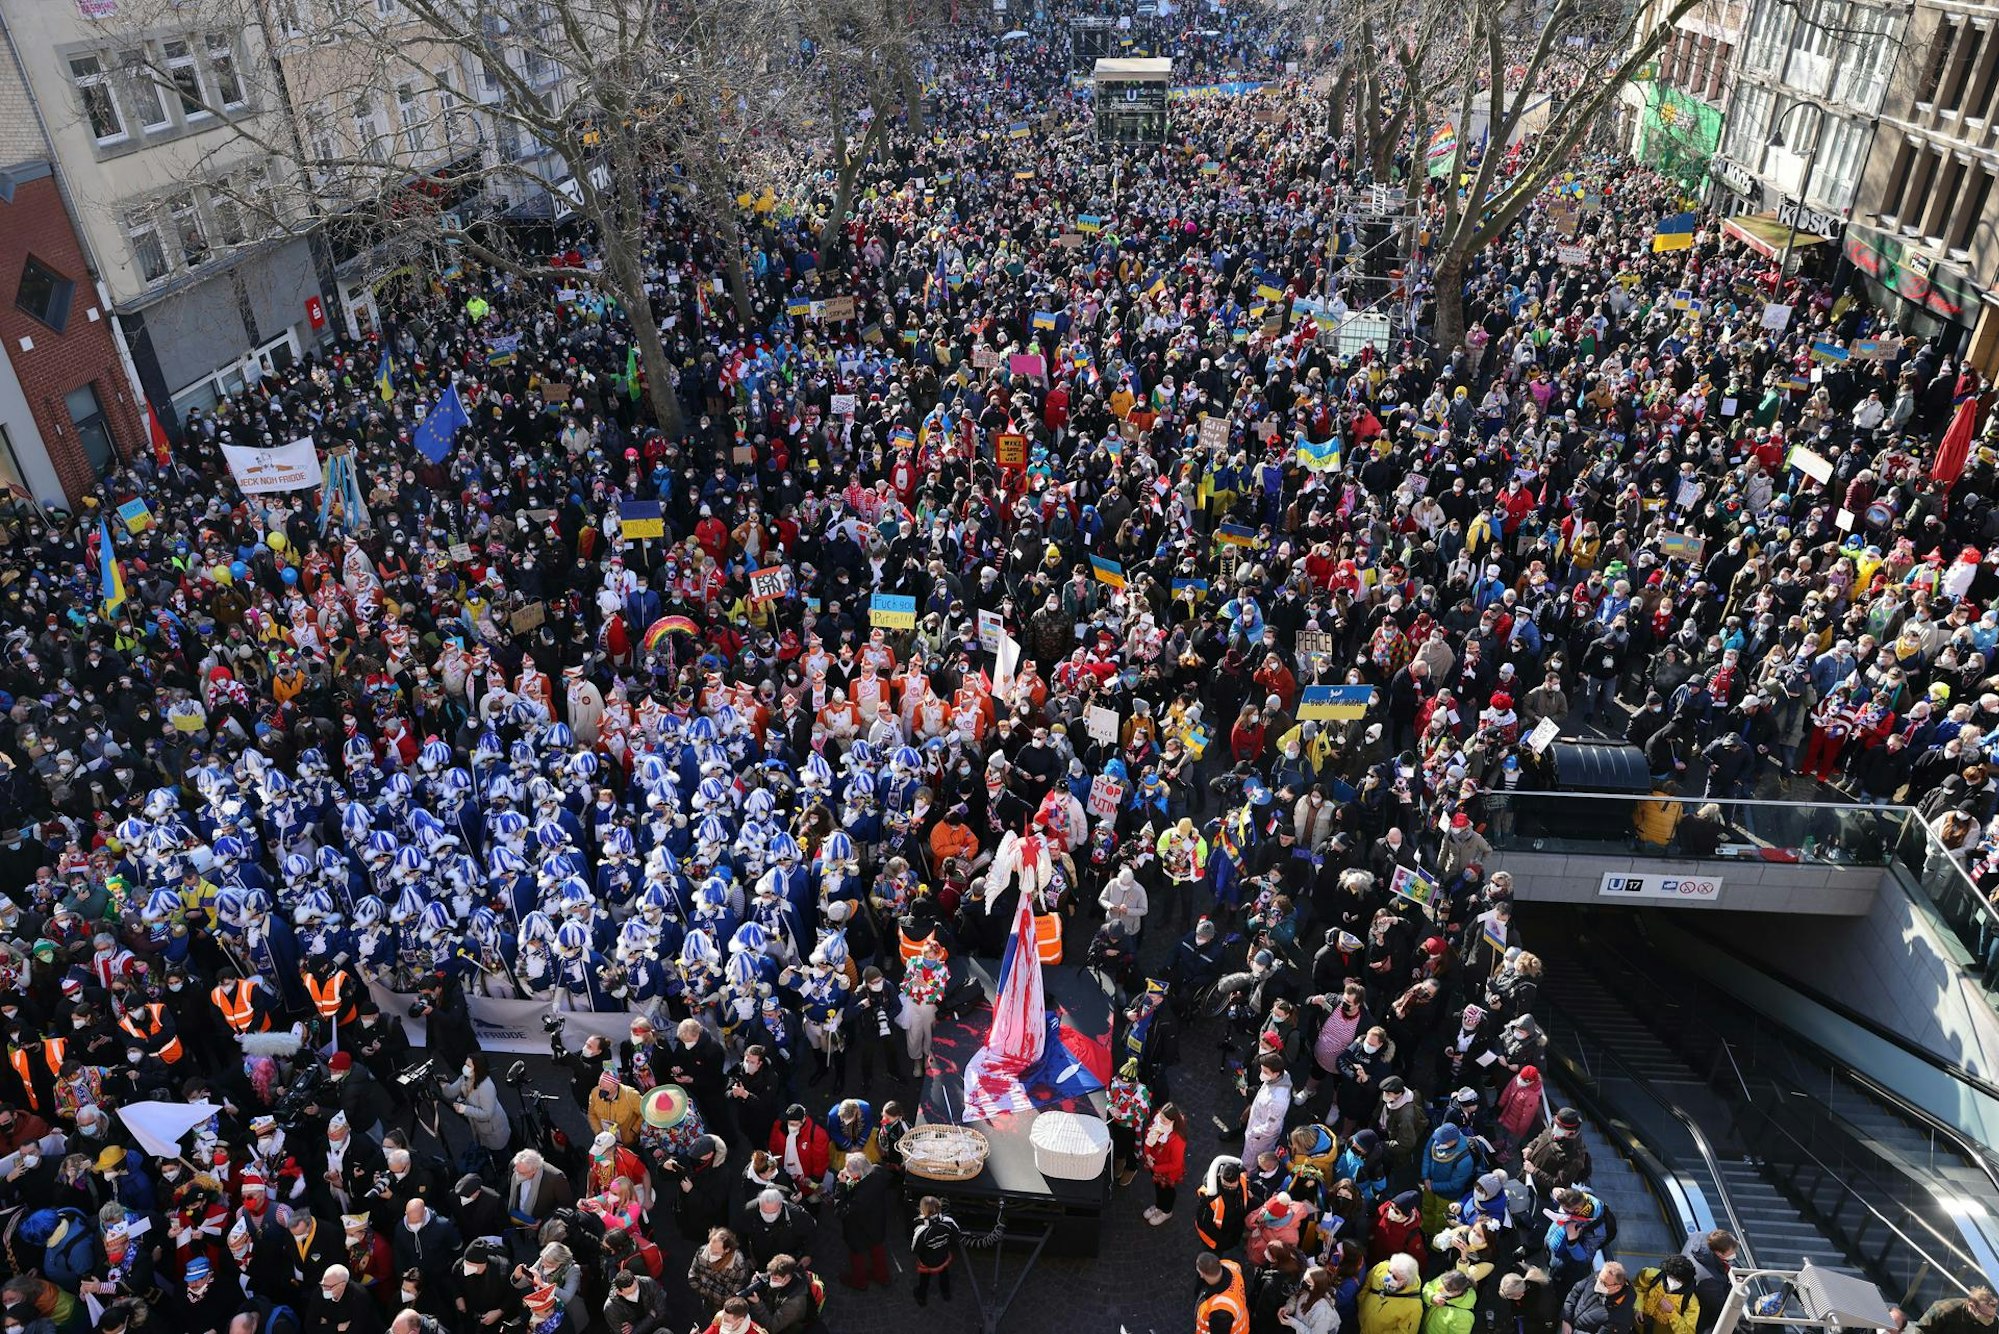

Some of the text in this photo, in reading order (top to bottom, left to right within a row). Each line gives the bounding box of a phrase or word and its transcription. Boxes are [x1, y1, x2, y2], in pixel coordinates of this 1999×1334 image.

[1126, 89, 1137, 102] U
[1779, 204, 1831, 237] KIOSK
[279, 472, 307, 483] FRIDDE
[755, 572, 779, 586] FCK
[758, 580, 782, 597] PTN
[1297, 631, 1332, 653] PEACE
[1093, 779, 1121, 798] STOP
[1089, 793, 1118, 814] PUTIN
[1609, 879, 1641, 891] U 17
[483, 1031, 527, 1039] FRIDDE
